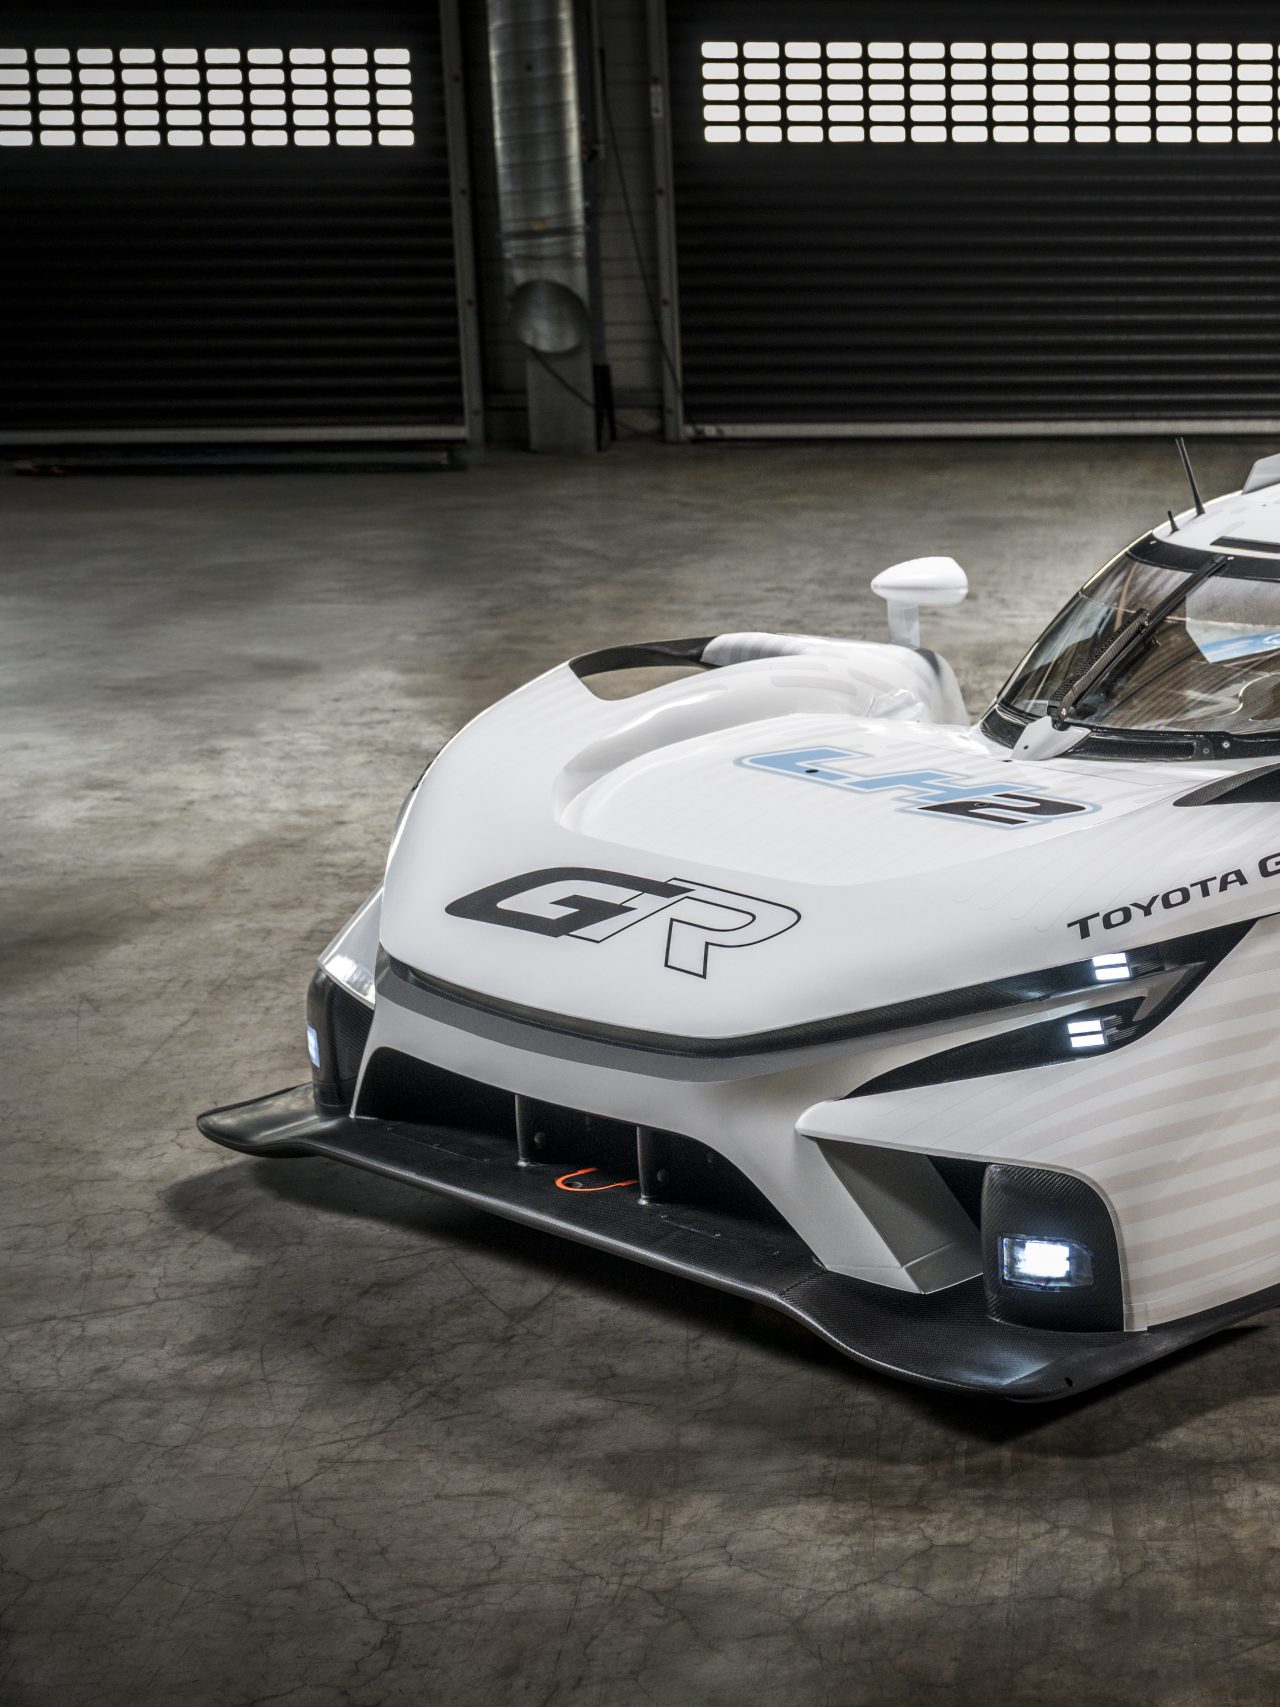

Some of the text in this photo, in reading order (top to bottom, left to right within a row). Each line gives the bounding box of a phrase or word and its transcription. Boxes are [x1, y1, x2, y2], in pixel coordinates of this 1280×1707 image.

[735, 747, 1100, 829] LH2
[445, 866, 801, 979] GR
[1066, 869, 1248, 940] TOYOTA
